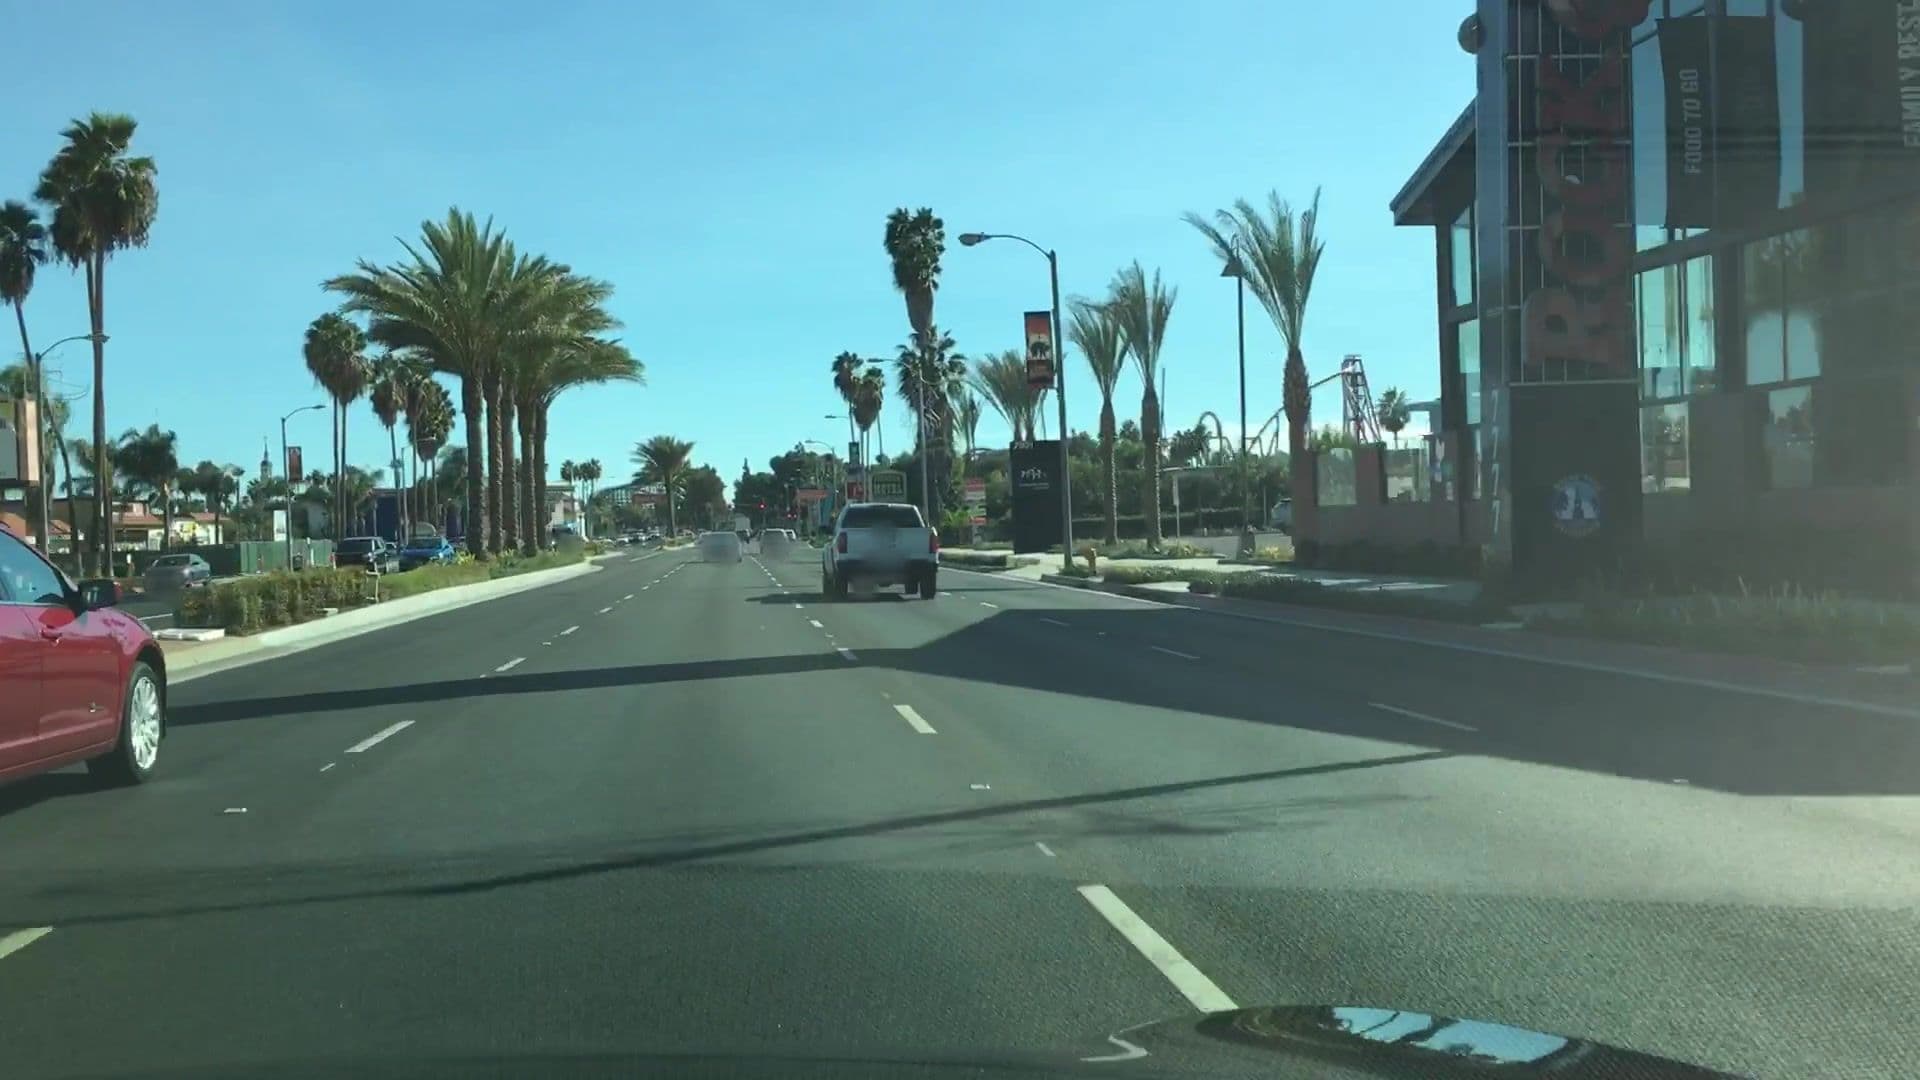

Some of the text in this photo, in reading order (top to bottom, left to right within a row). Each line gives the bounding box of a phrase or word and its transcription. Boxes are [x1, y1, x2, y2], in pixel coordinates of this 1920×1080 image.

[1678, 68, 1702, 176] FOOD TO GO
